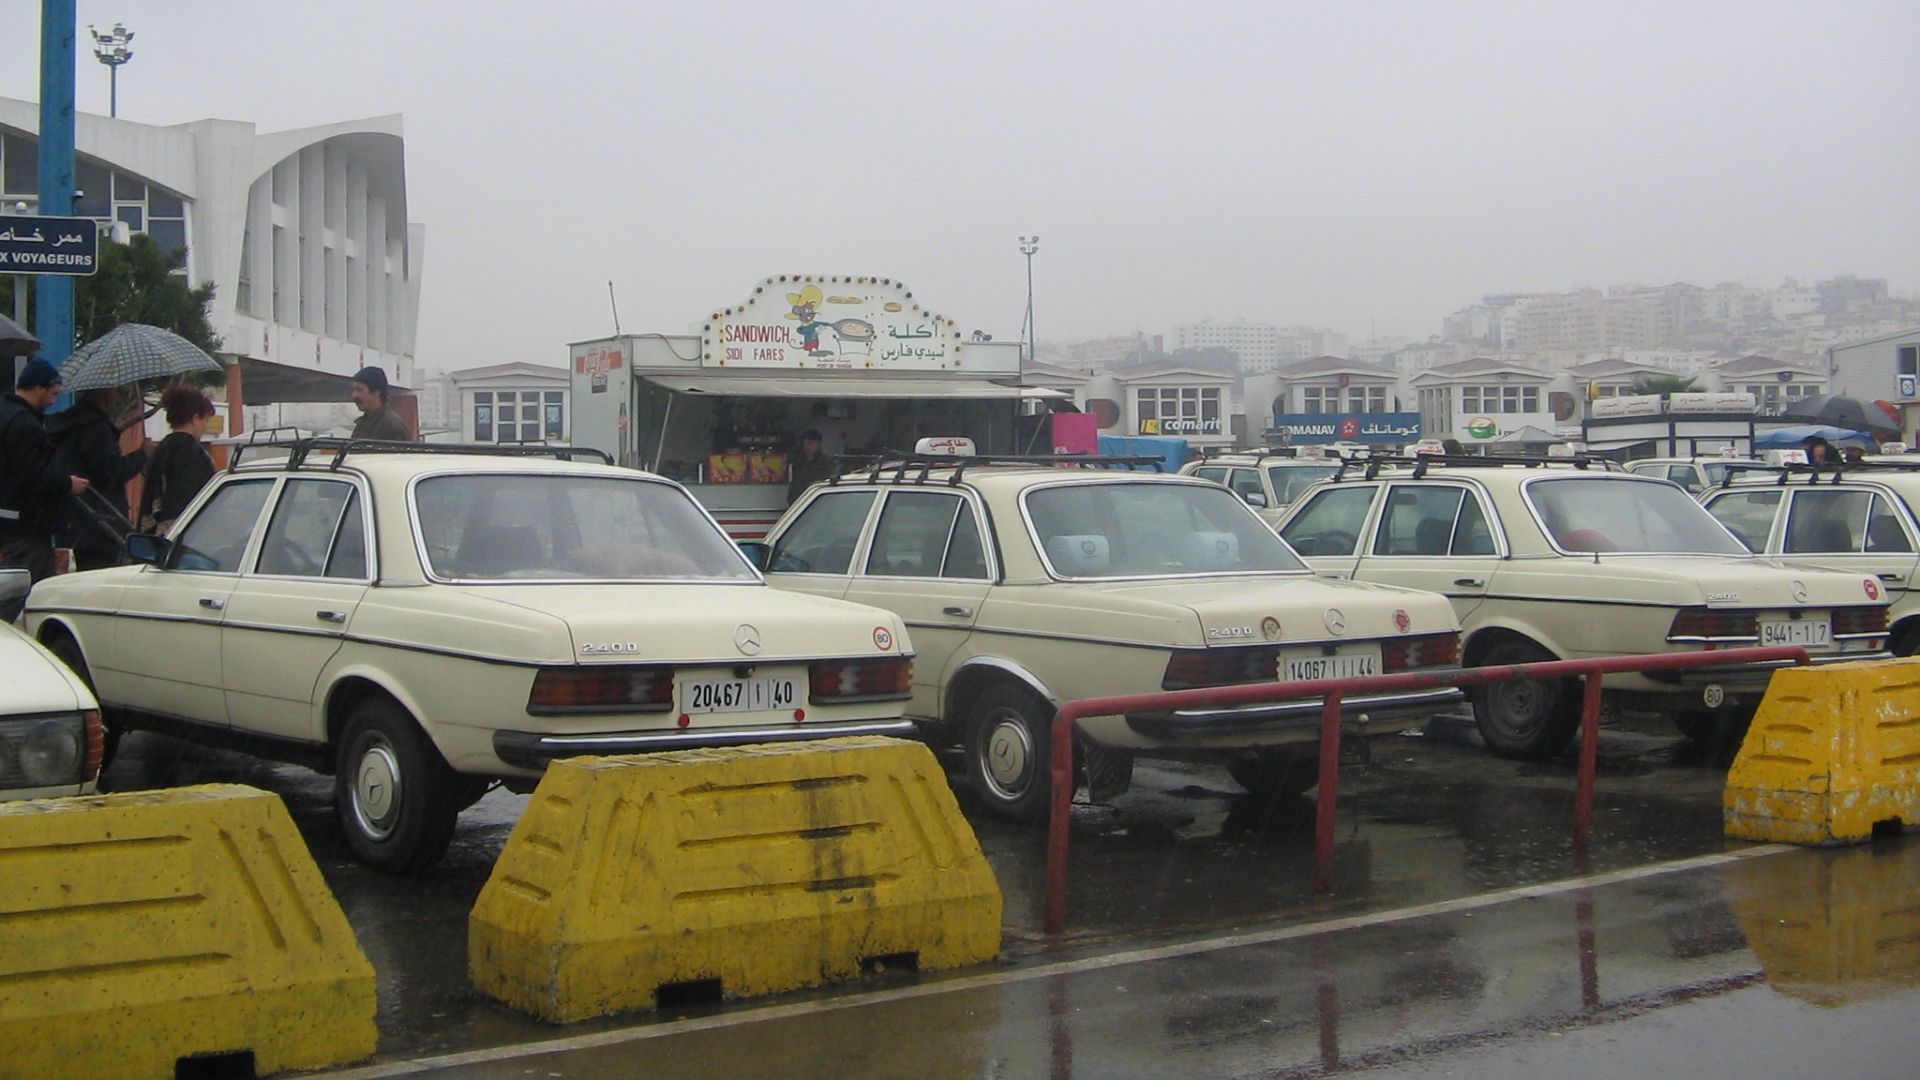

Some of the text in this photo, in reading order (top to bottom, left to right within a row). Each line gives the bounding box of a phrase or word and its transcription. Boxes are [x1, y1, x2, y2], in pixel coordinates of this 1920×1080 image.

[52, 234, 82, 247] ممر
[12, 253, 92, 266] VOYAGEURS
[725, 324, 789, 343] SANDWICH
[888, 320, 938, 338] أكلة
[726, 347, 784, 361] SIDI FARES
[881, 342, 944, 360] سيدي فارس
[1165, 417, 1221, 430] comarit
[877, 633, 888, 643] 80
[693, 683, 742, 708] 20467
[1707, 689, 1721, 703] 80
